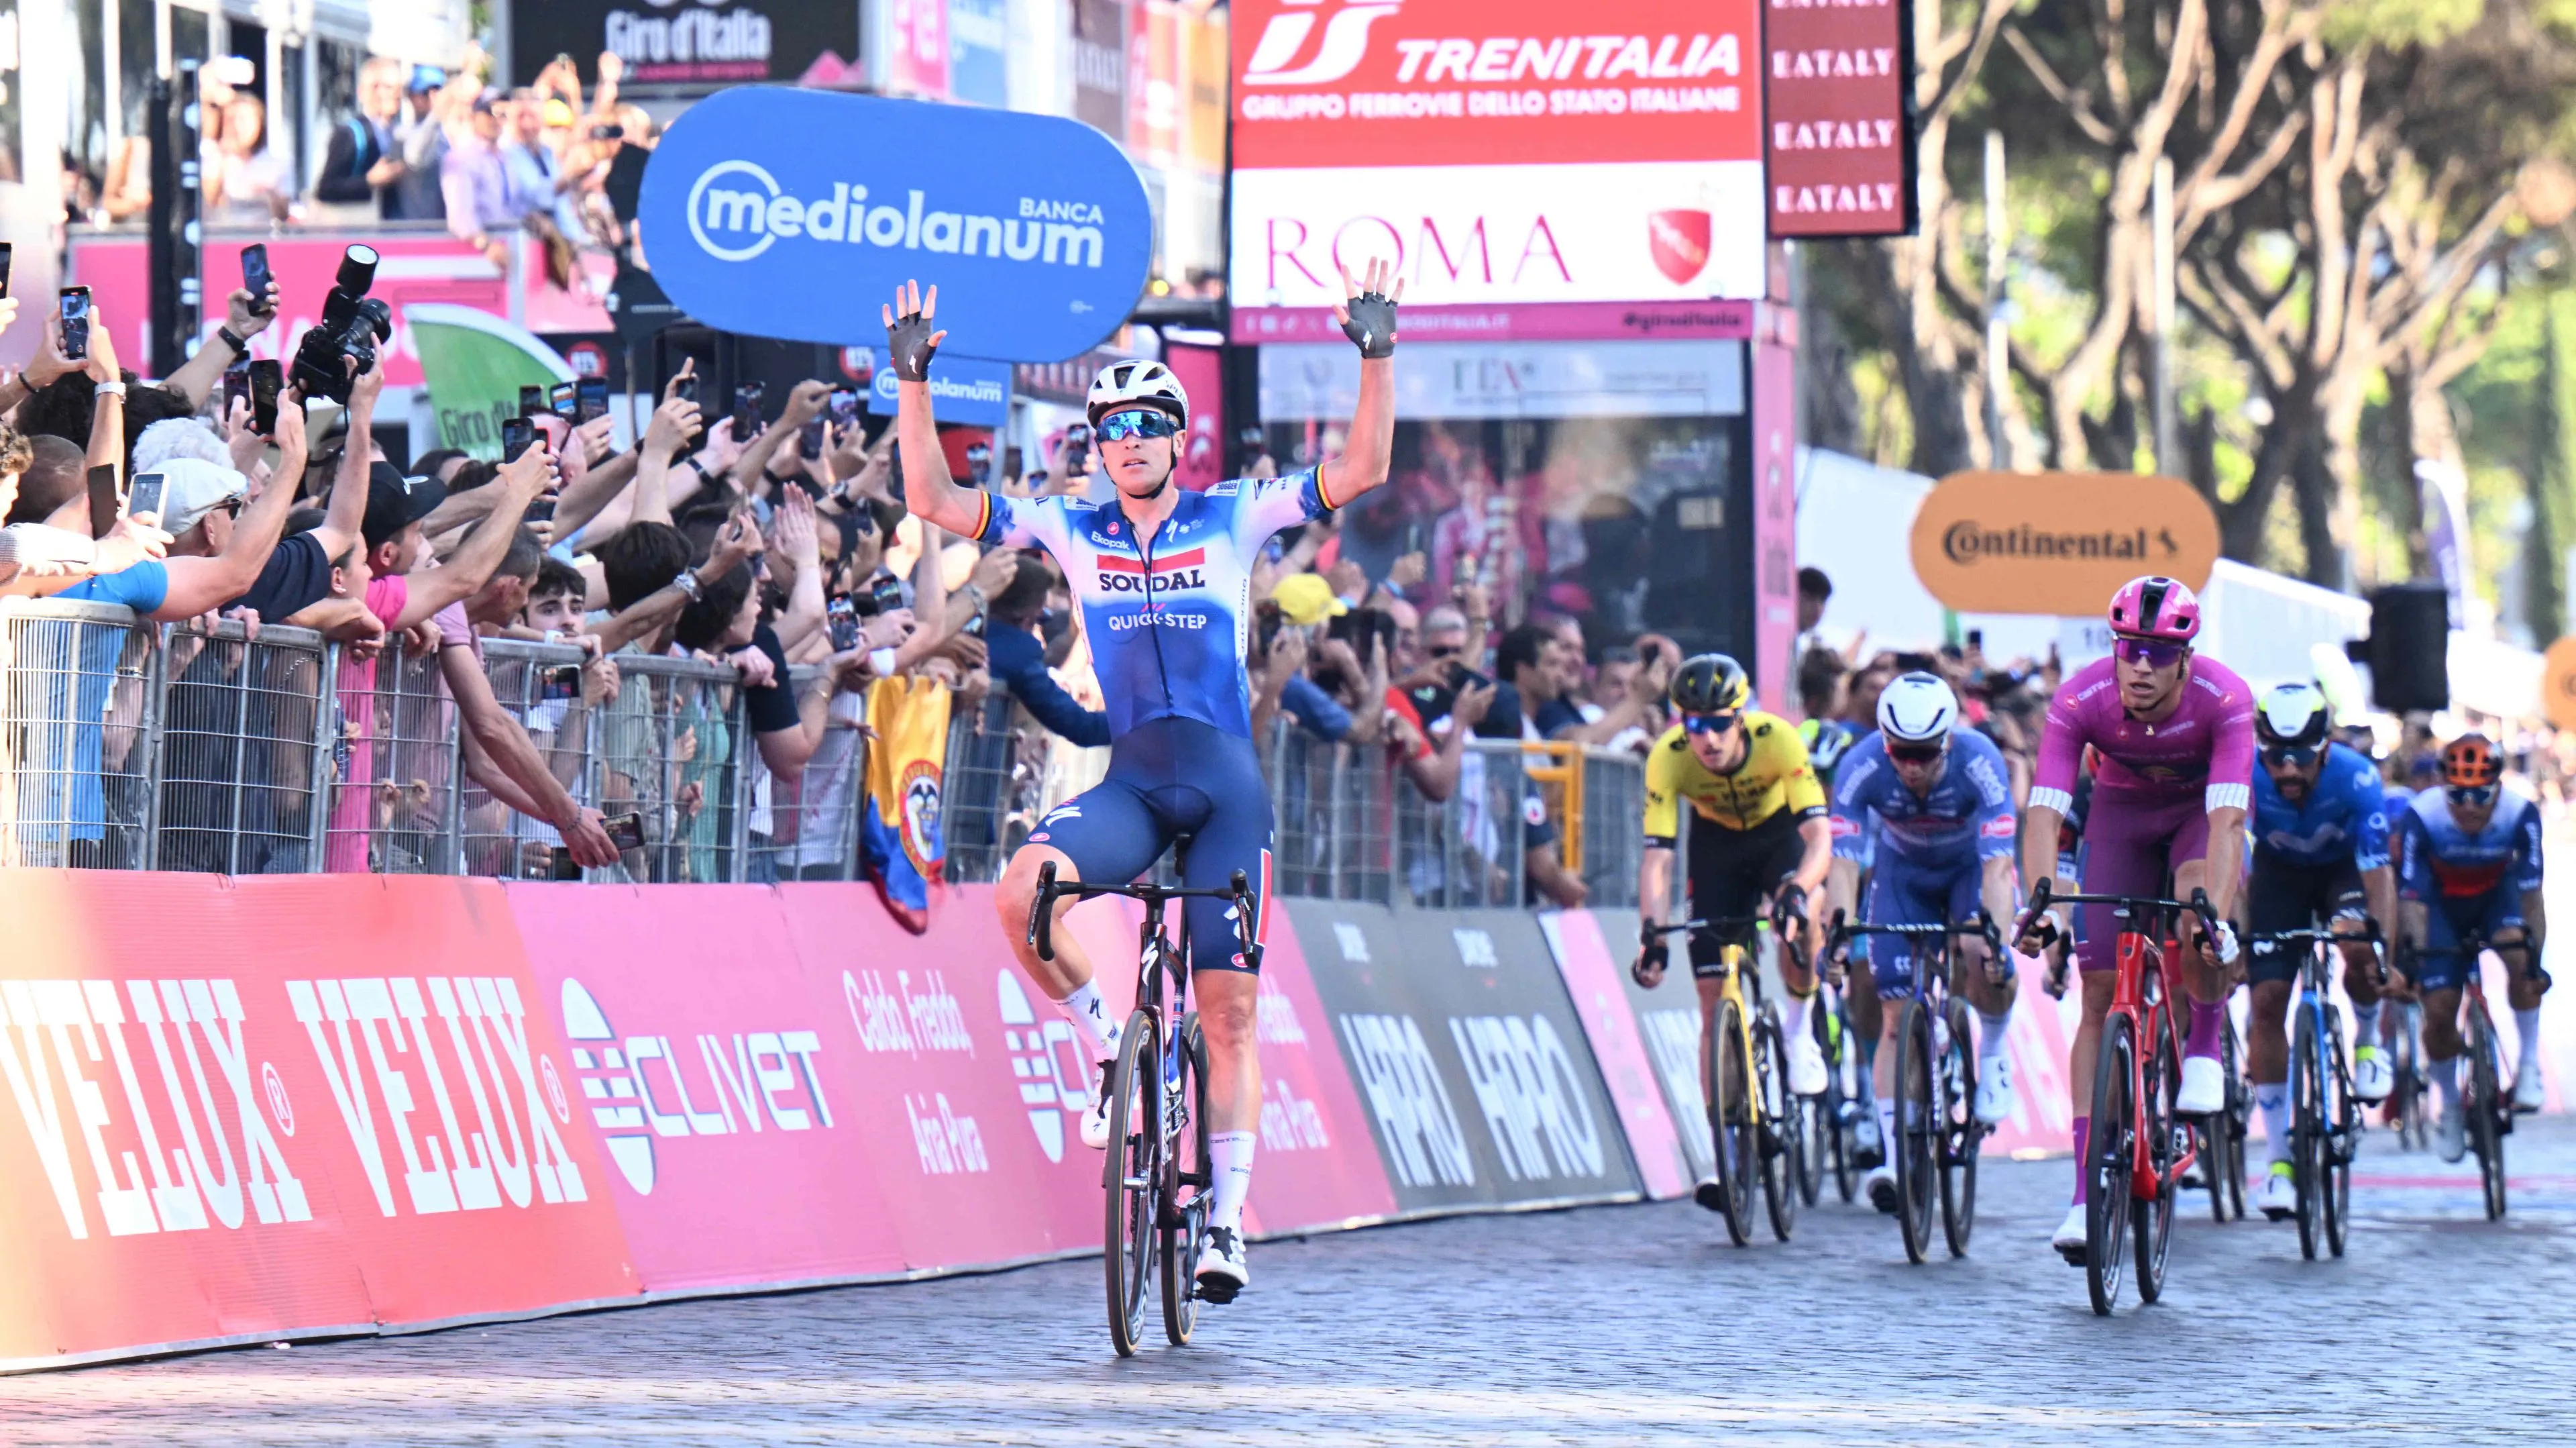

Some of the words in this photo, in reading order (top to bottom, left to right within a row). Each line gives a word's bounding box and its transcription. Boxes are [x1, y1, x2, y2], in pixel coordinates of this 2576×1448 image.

[606, 9, 669, 62] Giro
[1395, 33, 1740, 83] TRENITALIA
[1772, 48, 1894, 79] EATALY
[1242, 94, 1346, 121] GRUPPO
[1349, 91, 1463, 118] FERROVIE
[1468, 90, 1547, 116] DELLO
[1550, 88, 1628, 115] STATO
[1630, 85, 1740, 113] ITALIANE
[1774, 119, 1897, 150] EATALY
[1019, 197, 1104, 225] BANCA
[1776, 183, 1898, 213] EATALY
[706, 181, 1104, 268] mediolanum
[1267, 213, 1574, 289] ROMA
[1091, 530, 1130, 550] Ekopak
[1942, 519, 2146, 566] Continental
[1099, 569, 1205, 592] SOUDAL
[903, 1092, 955, 1174] Aria
[935, 1092, 990, 1173] Pura
